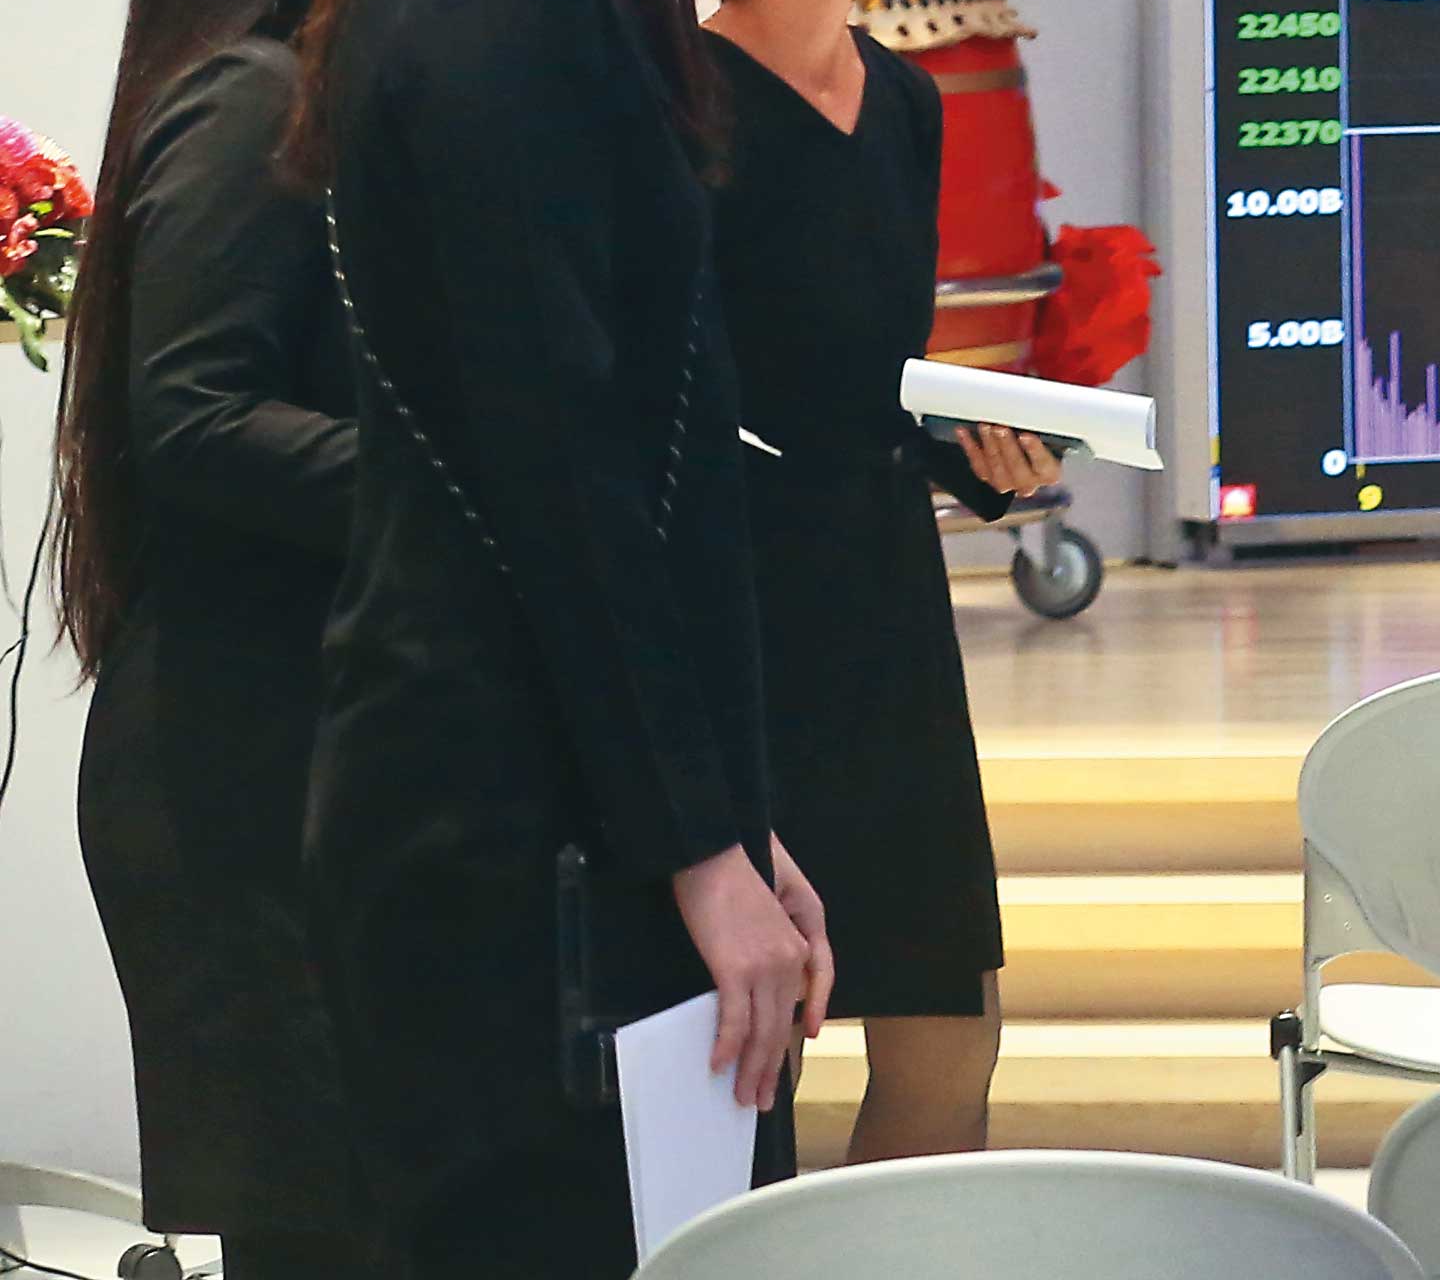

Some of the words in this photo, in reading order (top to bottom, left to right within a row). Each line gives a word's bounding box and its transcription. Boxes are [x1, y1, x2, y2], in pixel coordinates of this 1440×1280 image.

[1238, 12, 1342, 39] 22450
[1238, 120, 1343, 147] 22370
[1228, 185, 1345, 219] 10.00B
[1248, 317, 1347, 350] 5.00B
